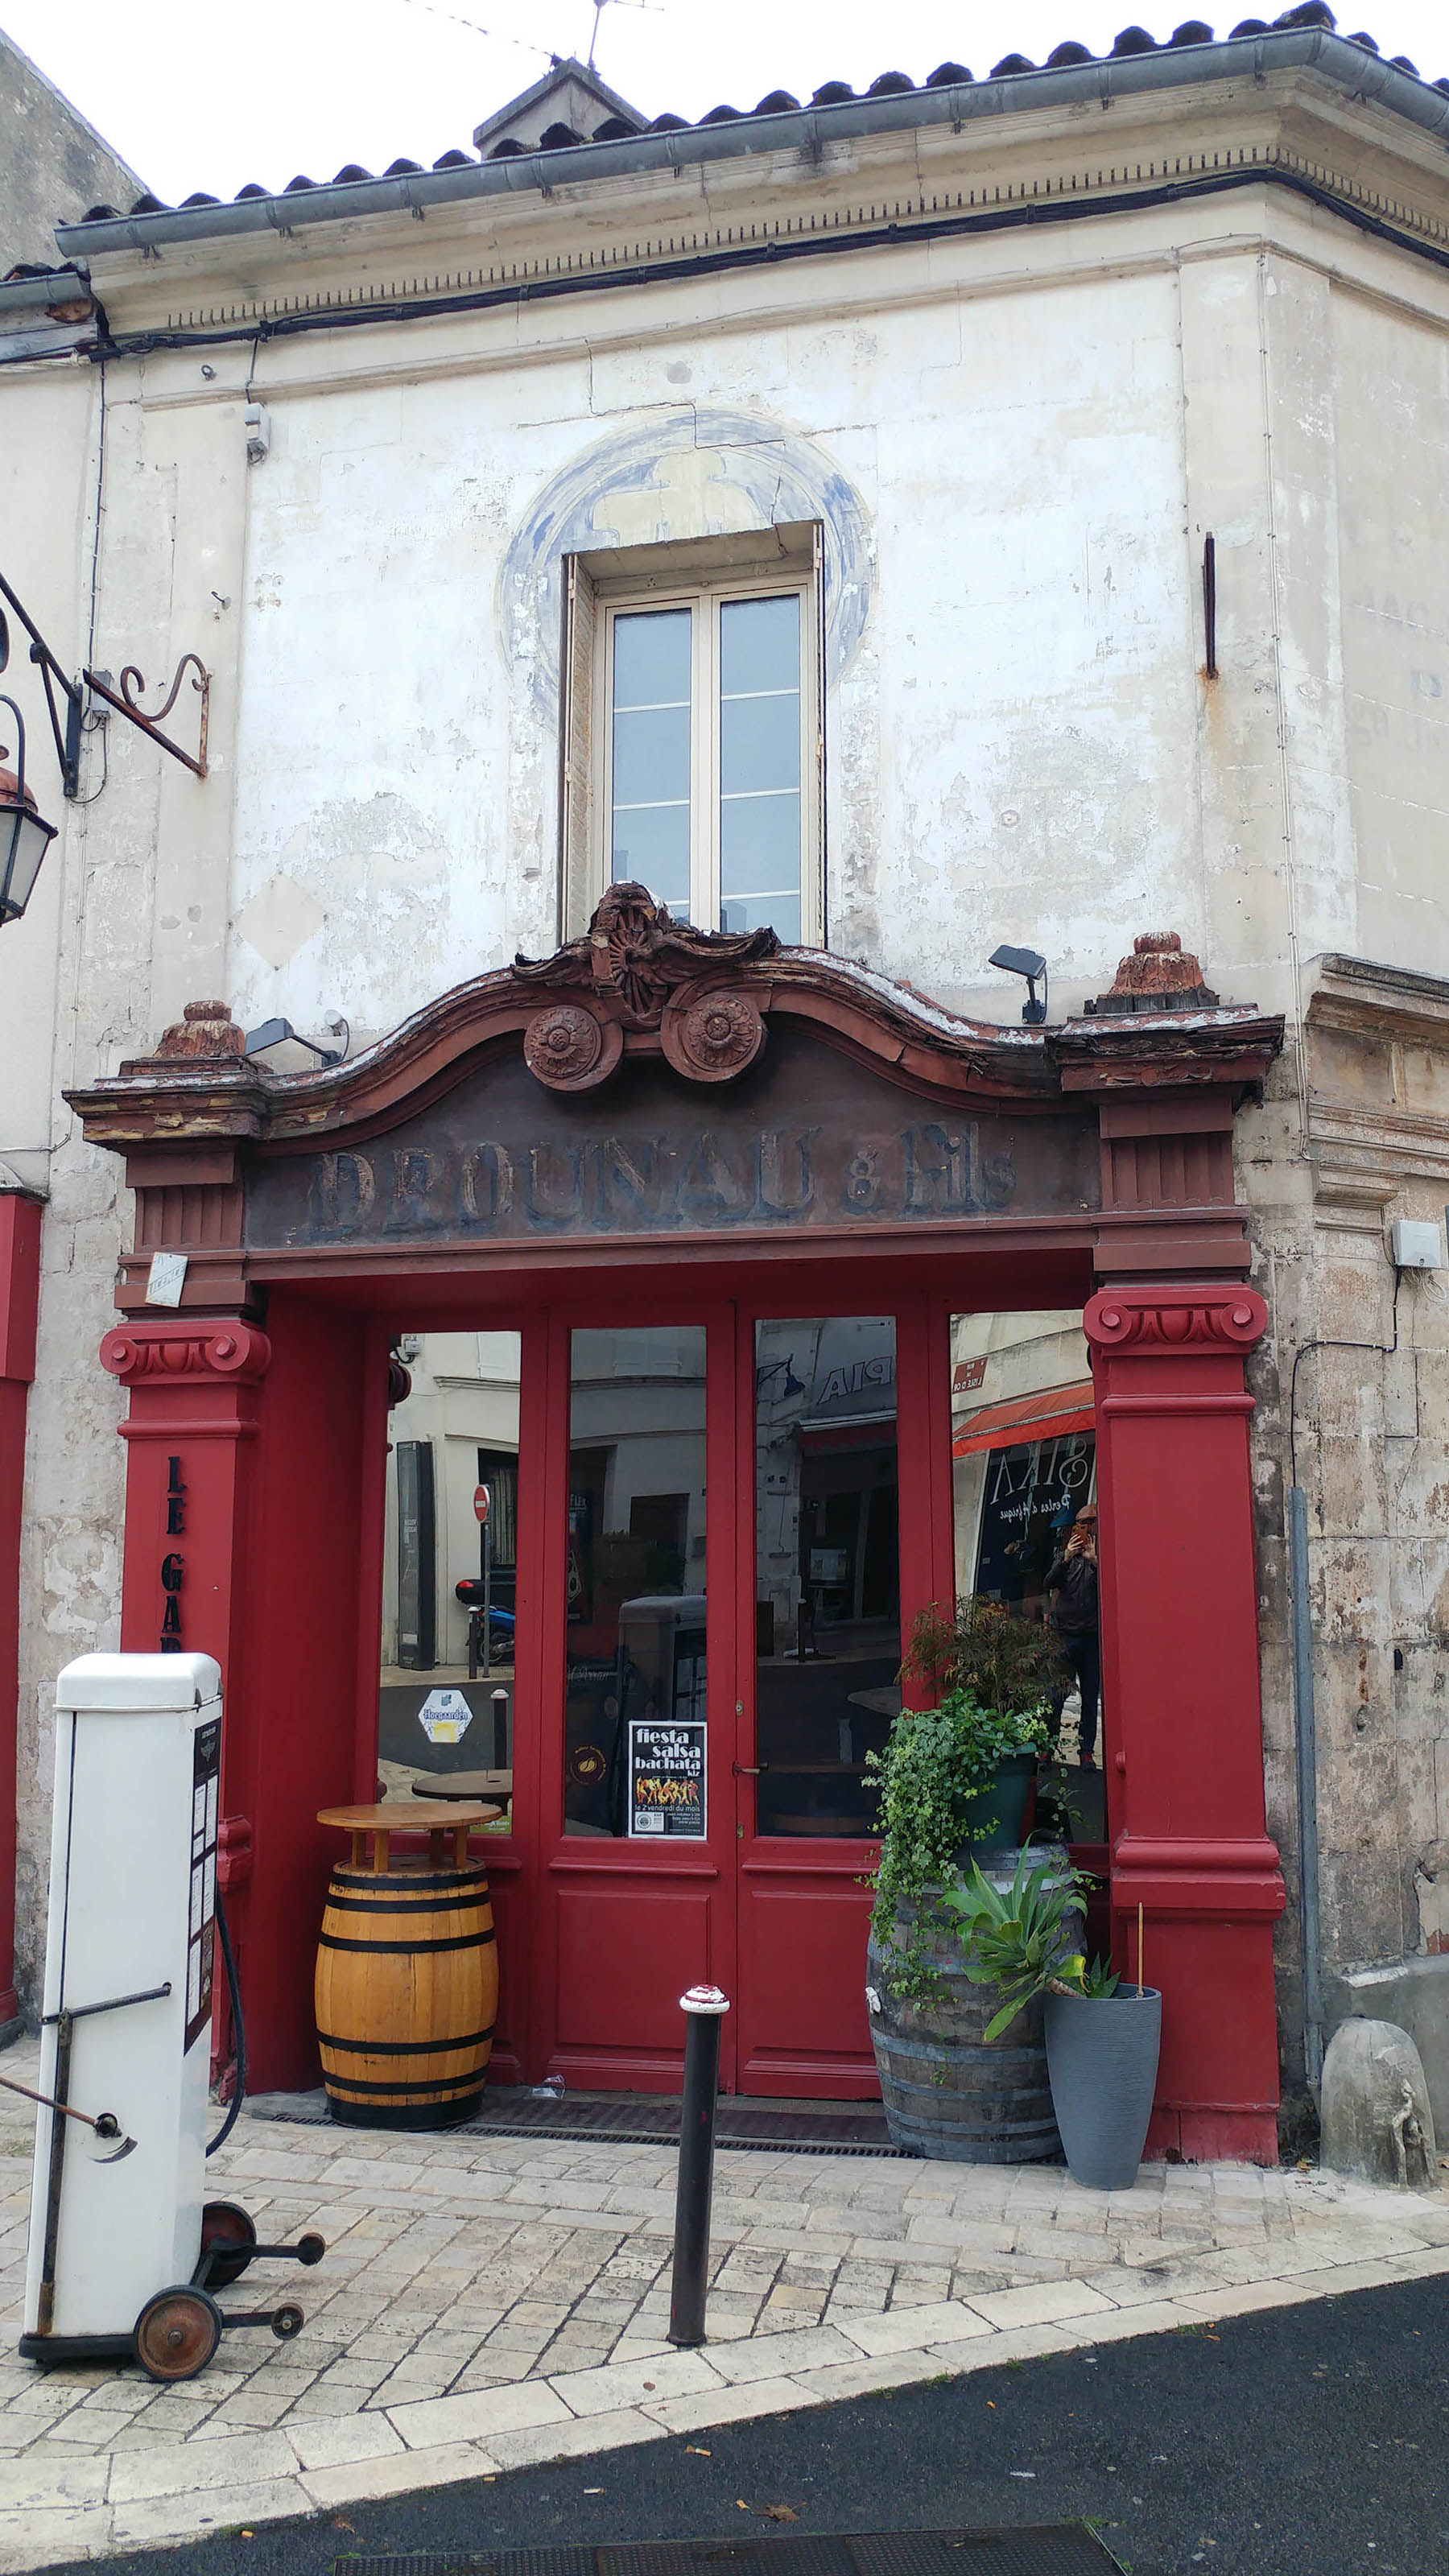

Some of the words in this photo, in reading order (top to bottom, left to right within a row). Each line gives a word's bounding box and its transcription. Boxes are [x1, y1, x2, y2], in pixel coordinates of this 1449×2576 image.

[423, 1709, 469, 1721] Hoegaarden
[636, 1728, 689, 1744] fiesta
[652, 1743, 700, 1758] salsa
[635, 1757, 700, 1769] bachata
